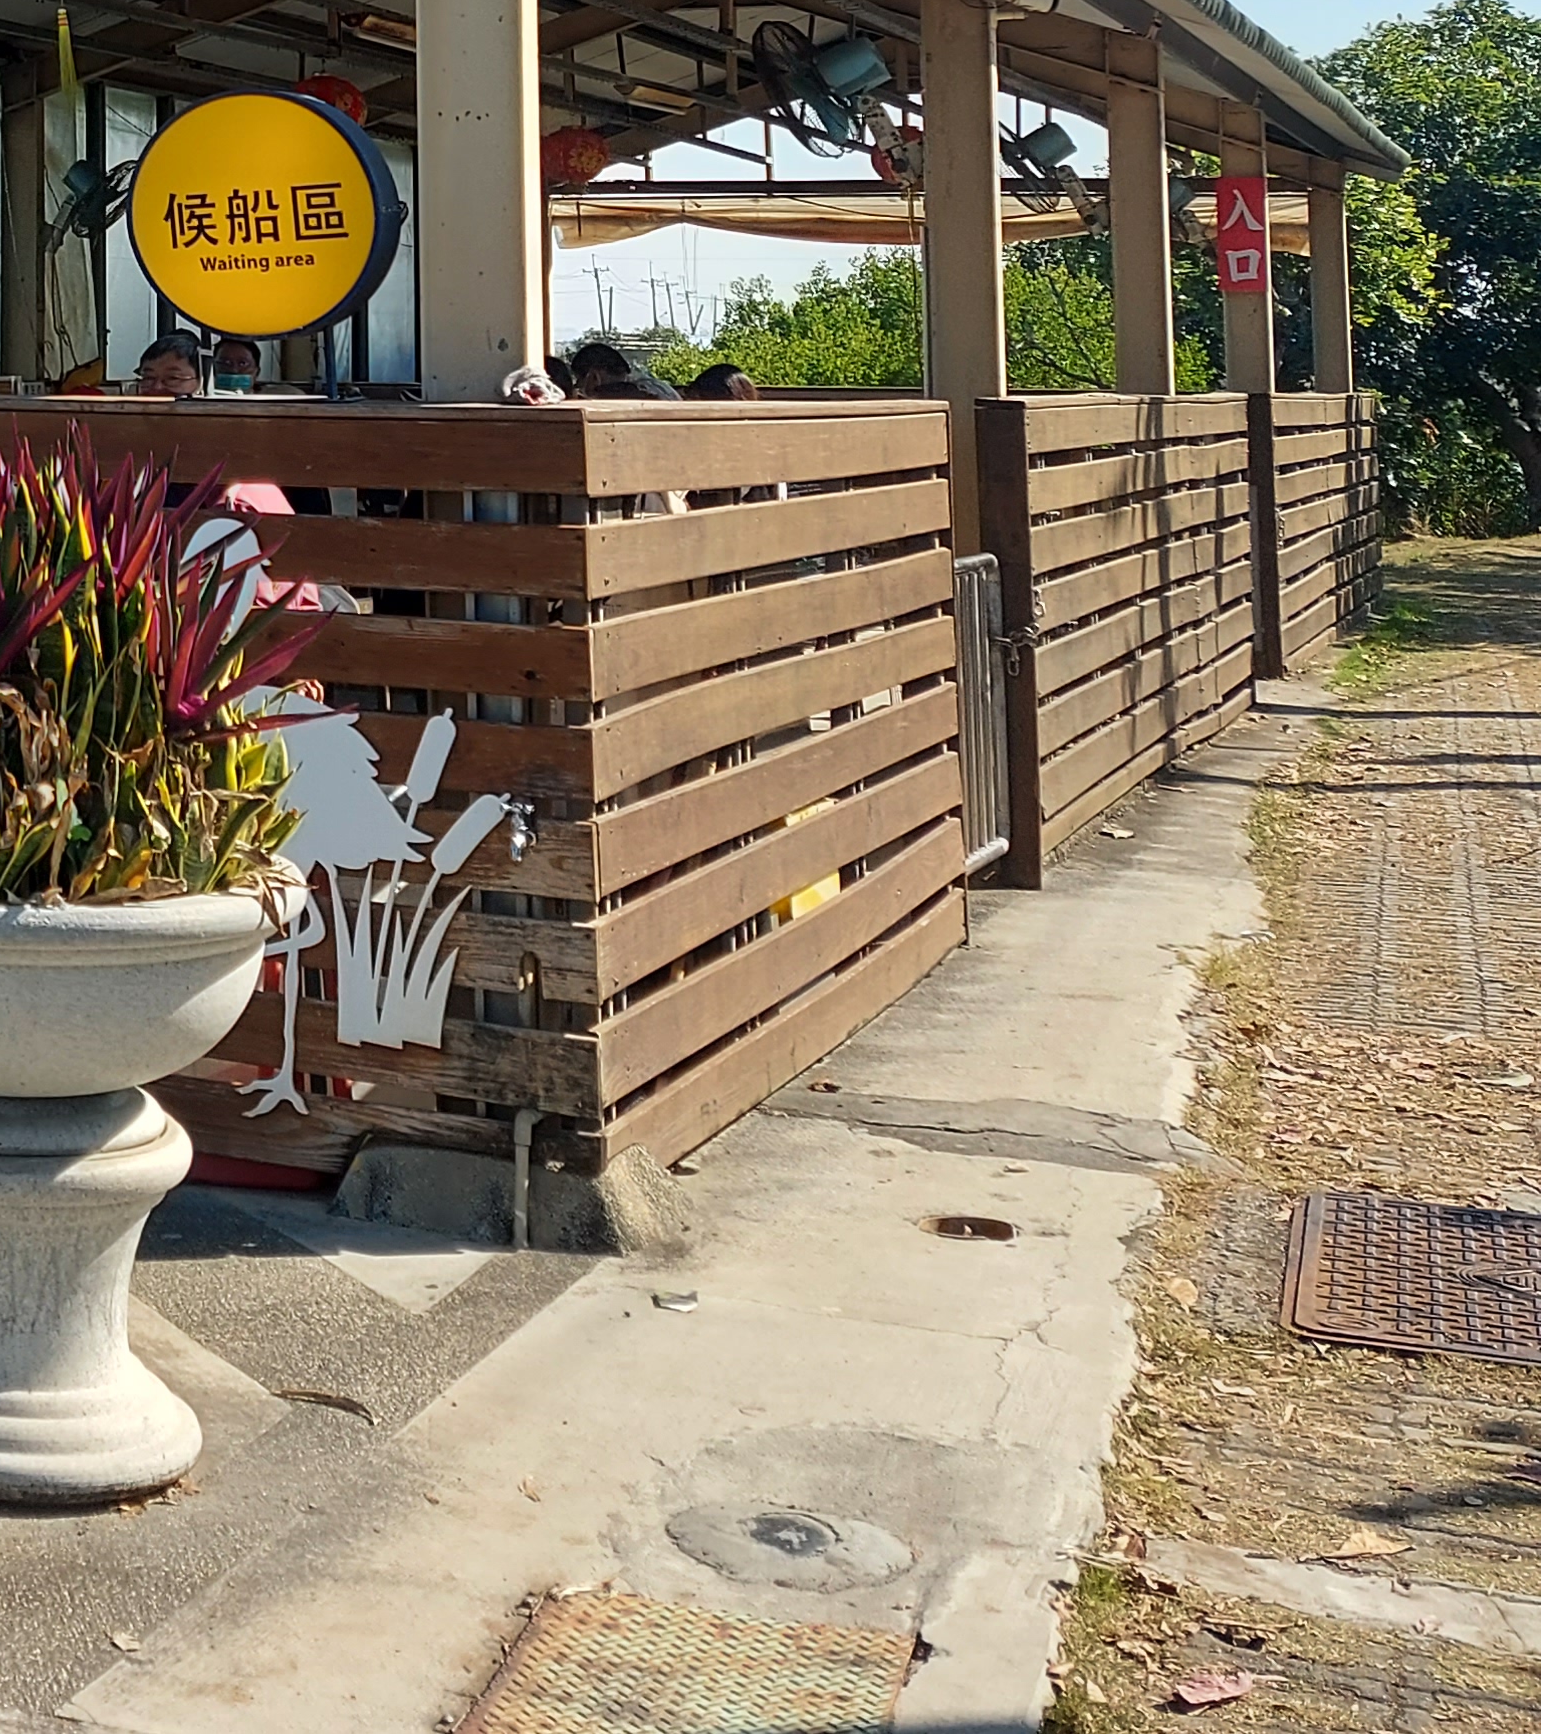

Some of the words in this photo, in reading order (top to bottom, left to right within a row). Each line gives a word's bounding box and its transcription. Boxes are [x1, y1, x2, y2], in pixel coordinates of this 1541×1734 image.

[163, 182, 350, 250] 候船區
[1222, 188, 1265, 283] 入口
[199, 254, 270, 272] Waiting
[275, 253, 315, 268] area
